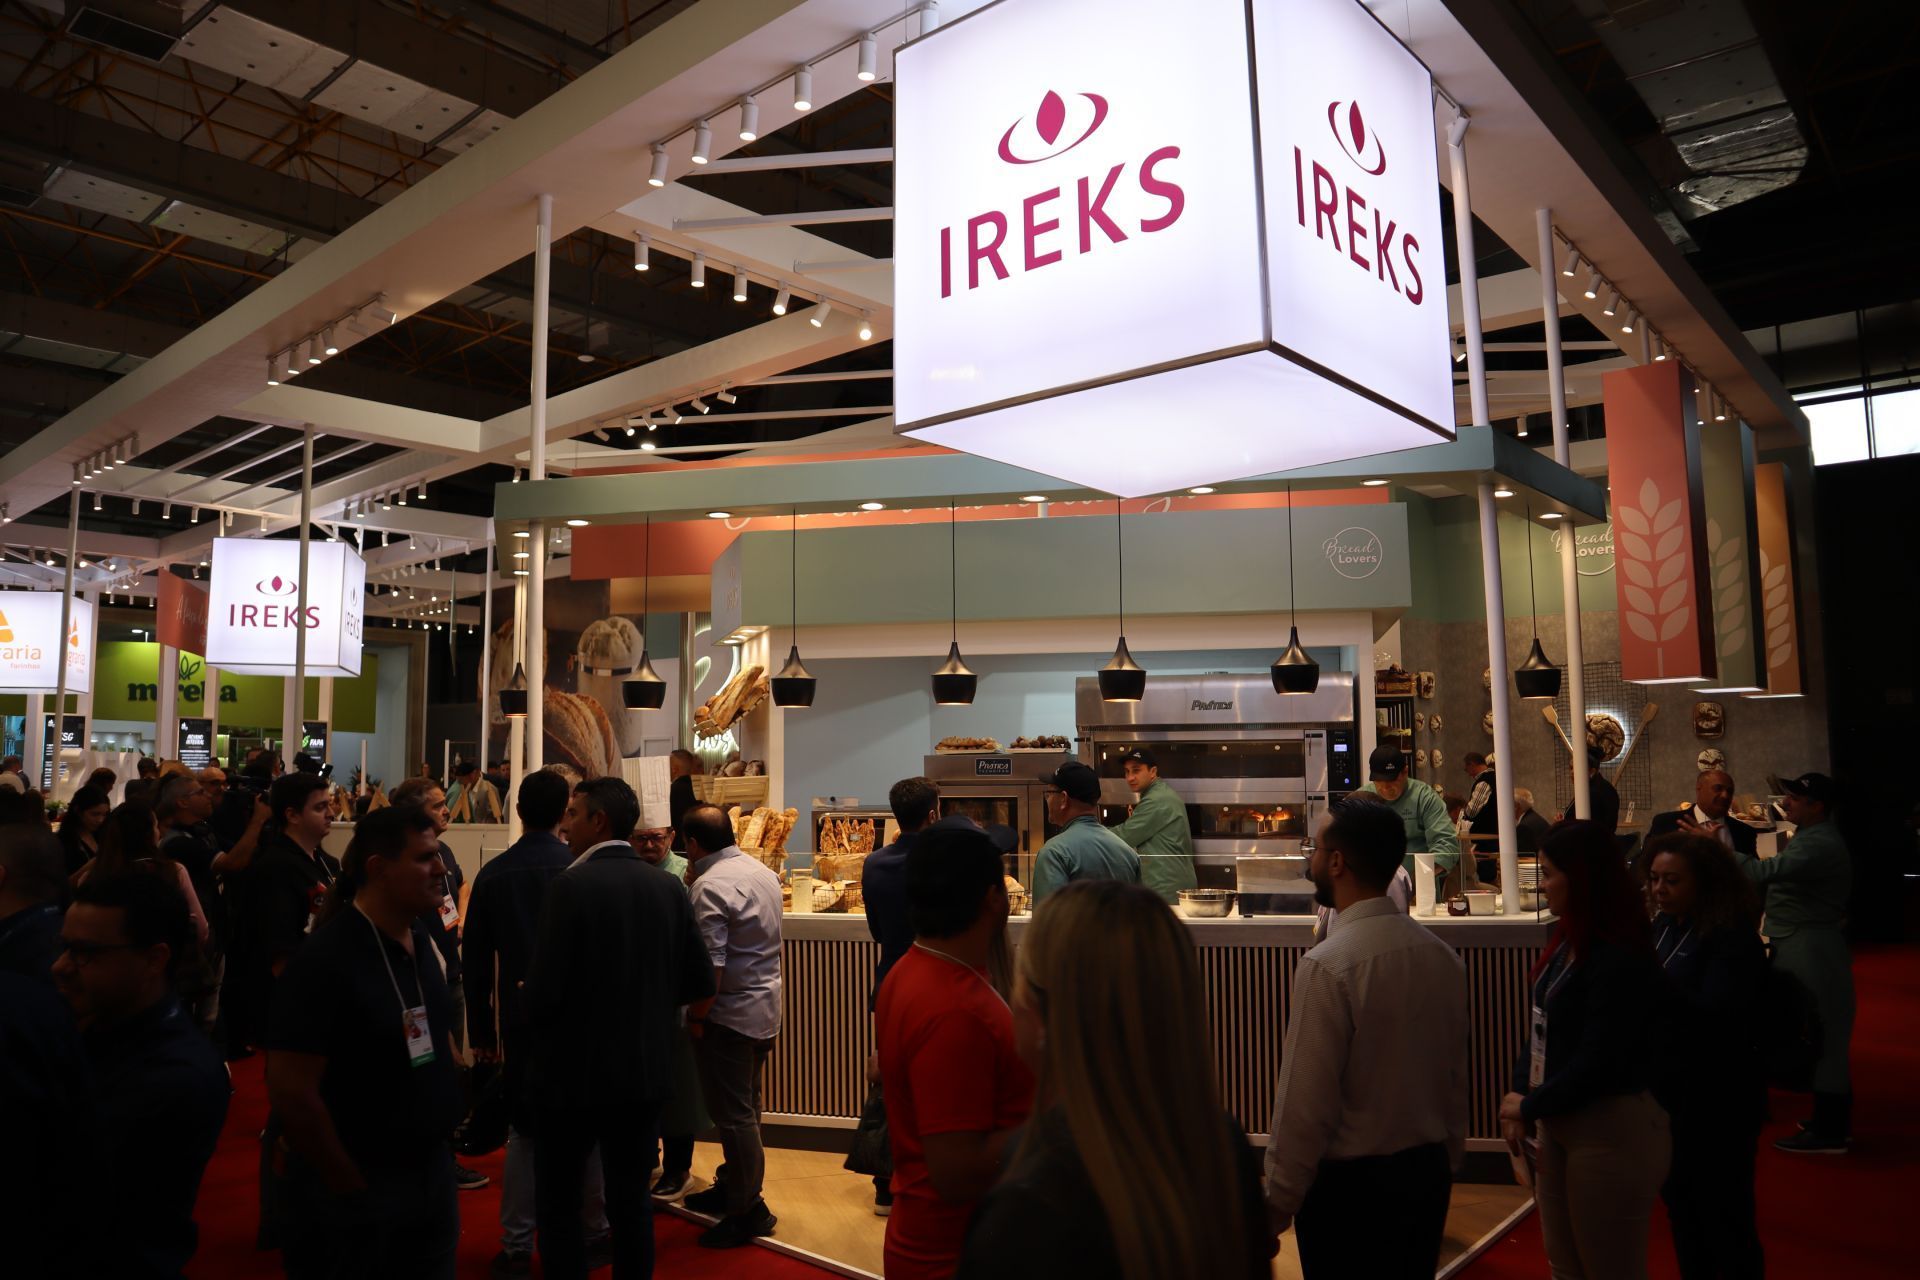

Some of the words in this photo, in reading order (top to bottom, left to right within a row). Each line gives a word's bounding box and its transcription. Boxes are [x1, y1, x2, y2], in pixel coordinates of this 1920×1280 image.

[940, 145, 1185, 298] IREKS
[1293, 145, 1424, 306] IREKS
[1322, 537, 1376, 559] Bread
[1338, 554, 1377, 564] Lovers
[229, 603, 320, 629] IREKS
[344, 609, 360, 640] IREKS
[0, 644, 41, 660] aria
[62, 732, 74, 741] SG
